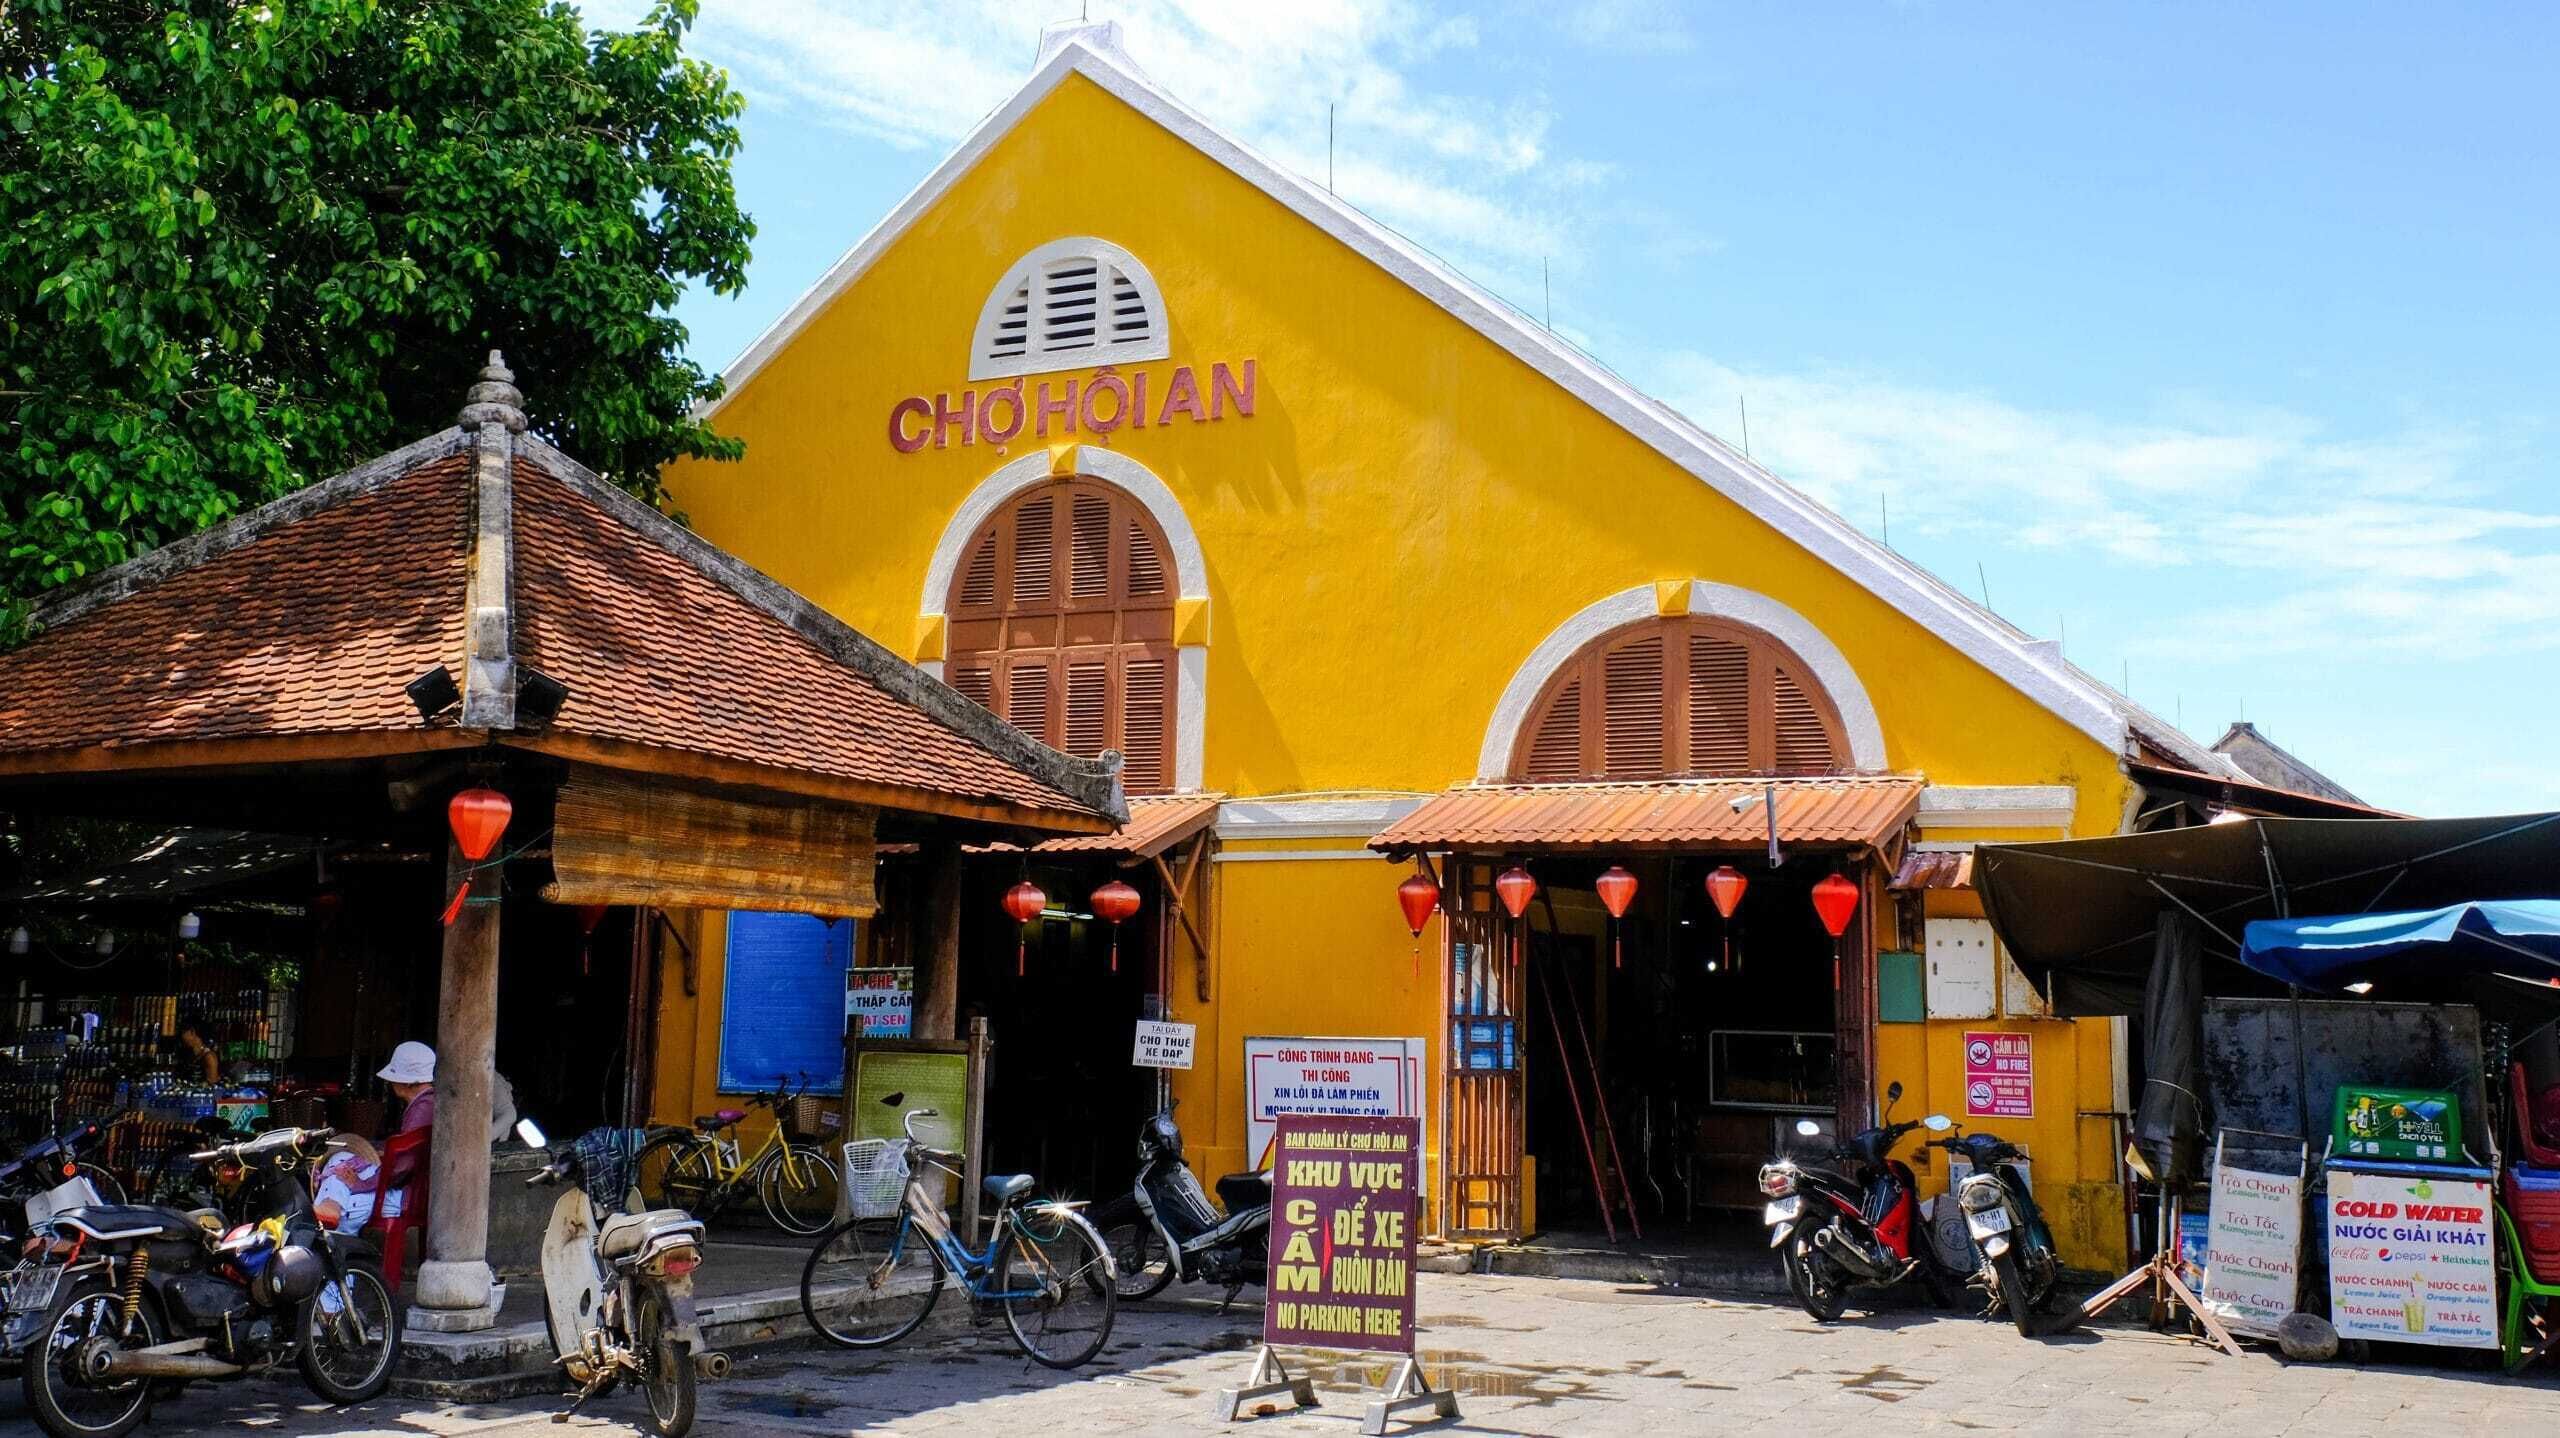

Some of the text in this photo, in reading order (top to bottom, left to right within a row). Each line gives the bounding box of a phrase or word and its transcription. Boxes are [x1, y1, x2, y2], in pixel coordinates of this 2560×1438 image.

[889, 359, 1256, 456] CHỢ HỘI AN
[882, 1014, 906, 1025] SEN
[1140, 1035, 1161, 1045] CHO
[1278, 1049, 1306, 1063] CÔNG
[1344, 1051, 1373, 1064] ĐANG
[1996, 1059, 2028, 1071] NO FIRE
[1302, 1067, 1350, 1083] THI CÔNG
[1274, 1087, 1290, 1098] XIN
[1285, 1132, 1303, 1148] BAN
[1337, 1130, 1350, 1149] LÝ
[1350, 1132, 1372, 1152] CHỢ
[1373, 1133, 1390, 1152] HỘI
[1393, 1134, 1407, 1149] AN
[1286, 1160, 1403, 1193] KHU VỰC
[2246, 1178, 2290, 1195] Chanh
[2227, 1211, 2248, 1225] Trà
[2335, 1200, 2484, 1224] COLD WATER
[1333, 1195, 1404, 1248] ĐỂ XE
[2335, 1222, 2487, 1246] NƯỚC GIẢI KHÁT
[2248, 1256, 2293, 1274] Chanh
[2395, 1251, 2426, 1263] pepsi
[2442, 1255, 2490, 1265] Heineken
[1332, 1250, 1406, 1296] BUÔN BÁN
[2370, 1276, 2410, 1288] CHANH
[2463, 1282, 2488, 1292] CAM
[2250, 1294, 2284, 1310] Cam
[1277, 1302, 1402, 1336] NO PARKING HERE
[2366, 1307, 2404, 1318] CHANH
